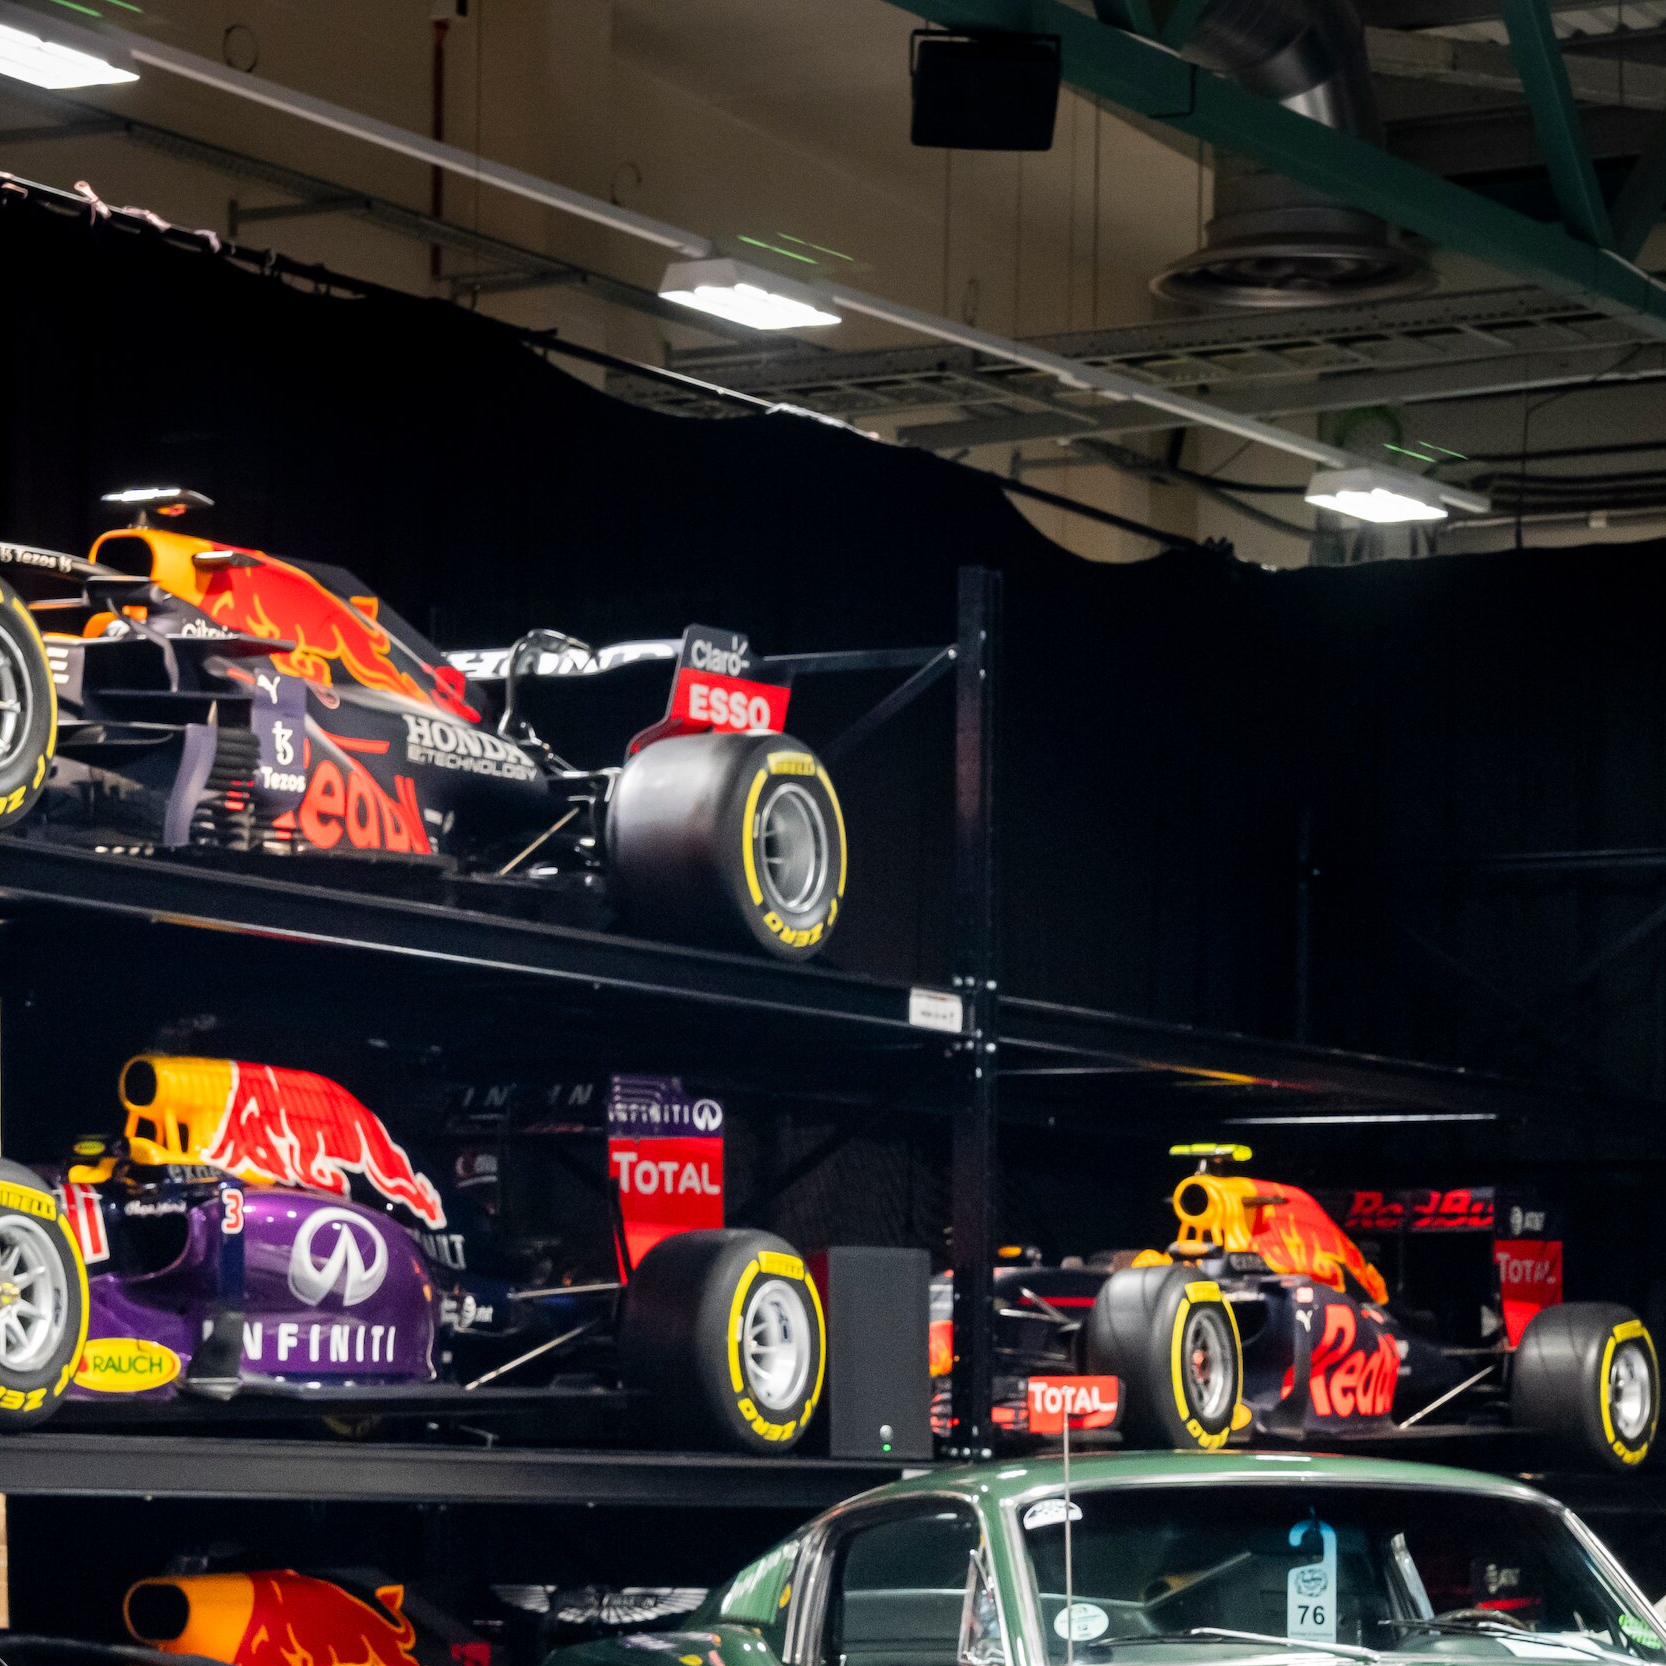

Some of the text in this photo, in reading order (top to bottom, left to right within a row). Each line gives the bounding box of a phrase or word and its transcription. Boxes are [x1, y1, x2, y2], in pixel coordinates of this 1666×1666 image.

[15, 548, 57, 568] Tezos
[690, 638, 739, 675] Claro
[689, 684, 771, 730] ESSO
[402, 713, 535, 767] HONDA
[260, 766, 306, 792] Tezos
[613, 1152, 720, 1195] TOTAL
[222, 1188, 244, 1234] 3
[93, 1355, 163, 1374] RAUCH
[1033, 1383, 1117, 1414] TOTAL
[1298, 1605, 1325, 1625] 76
